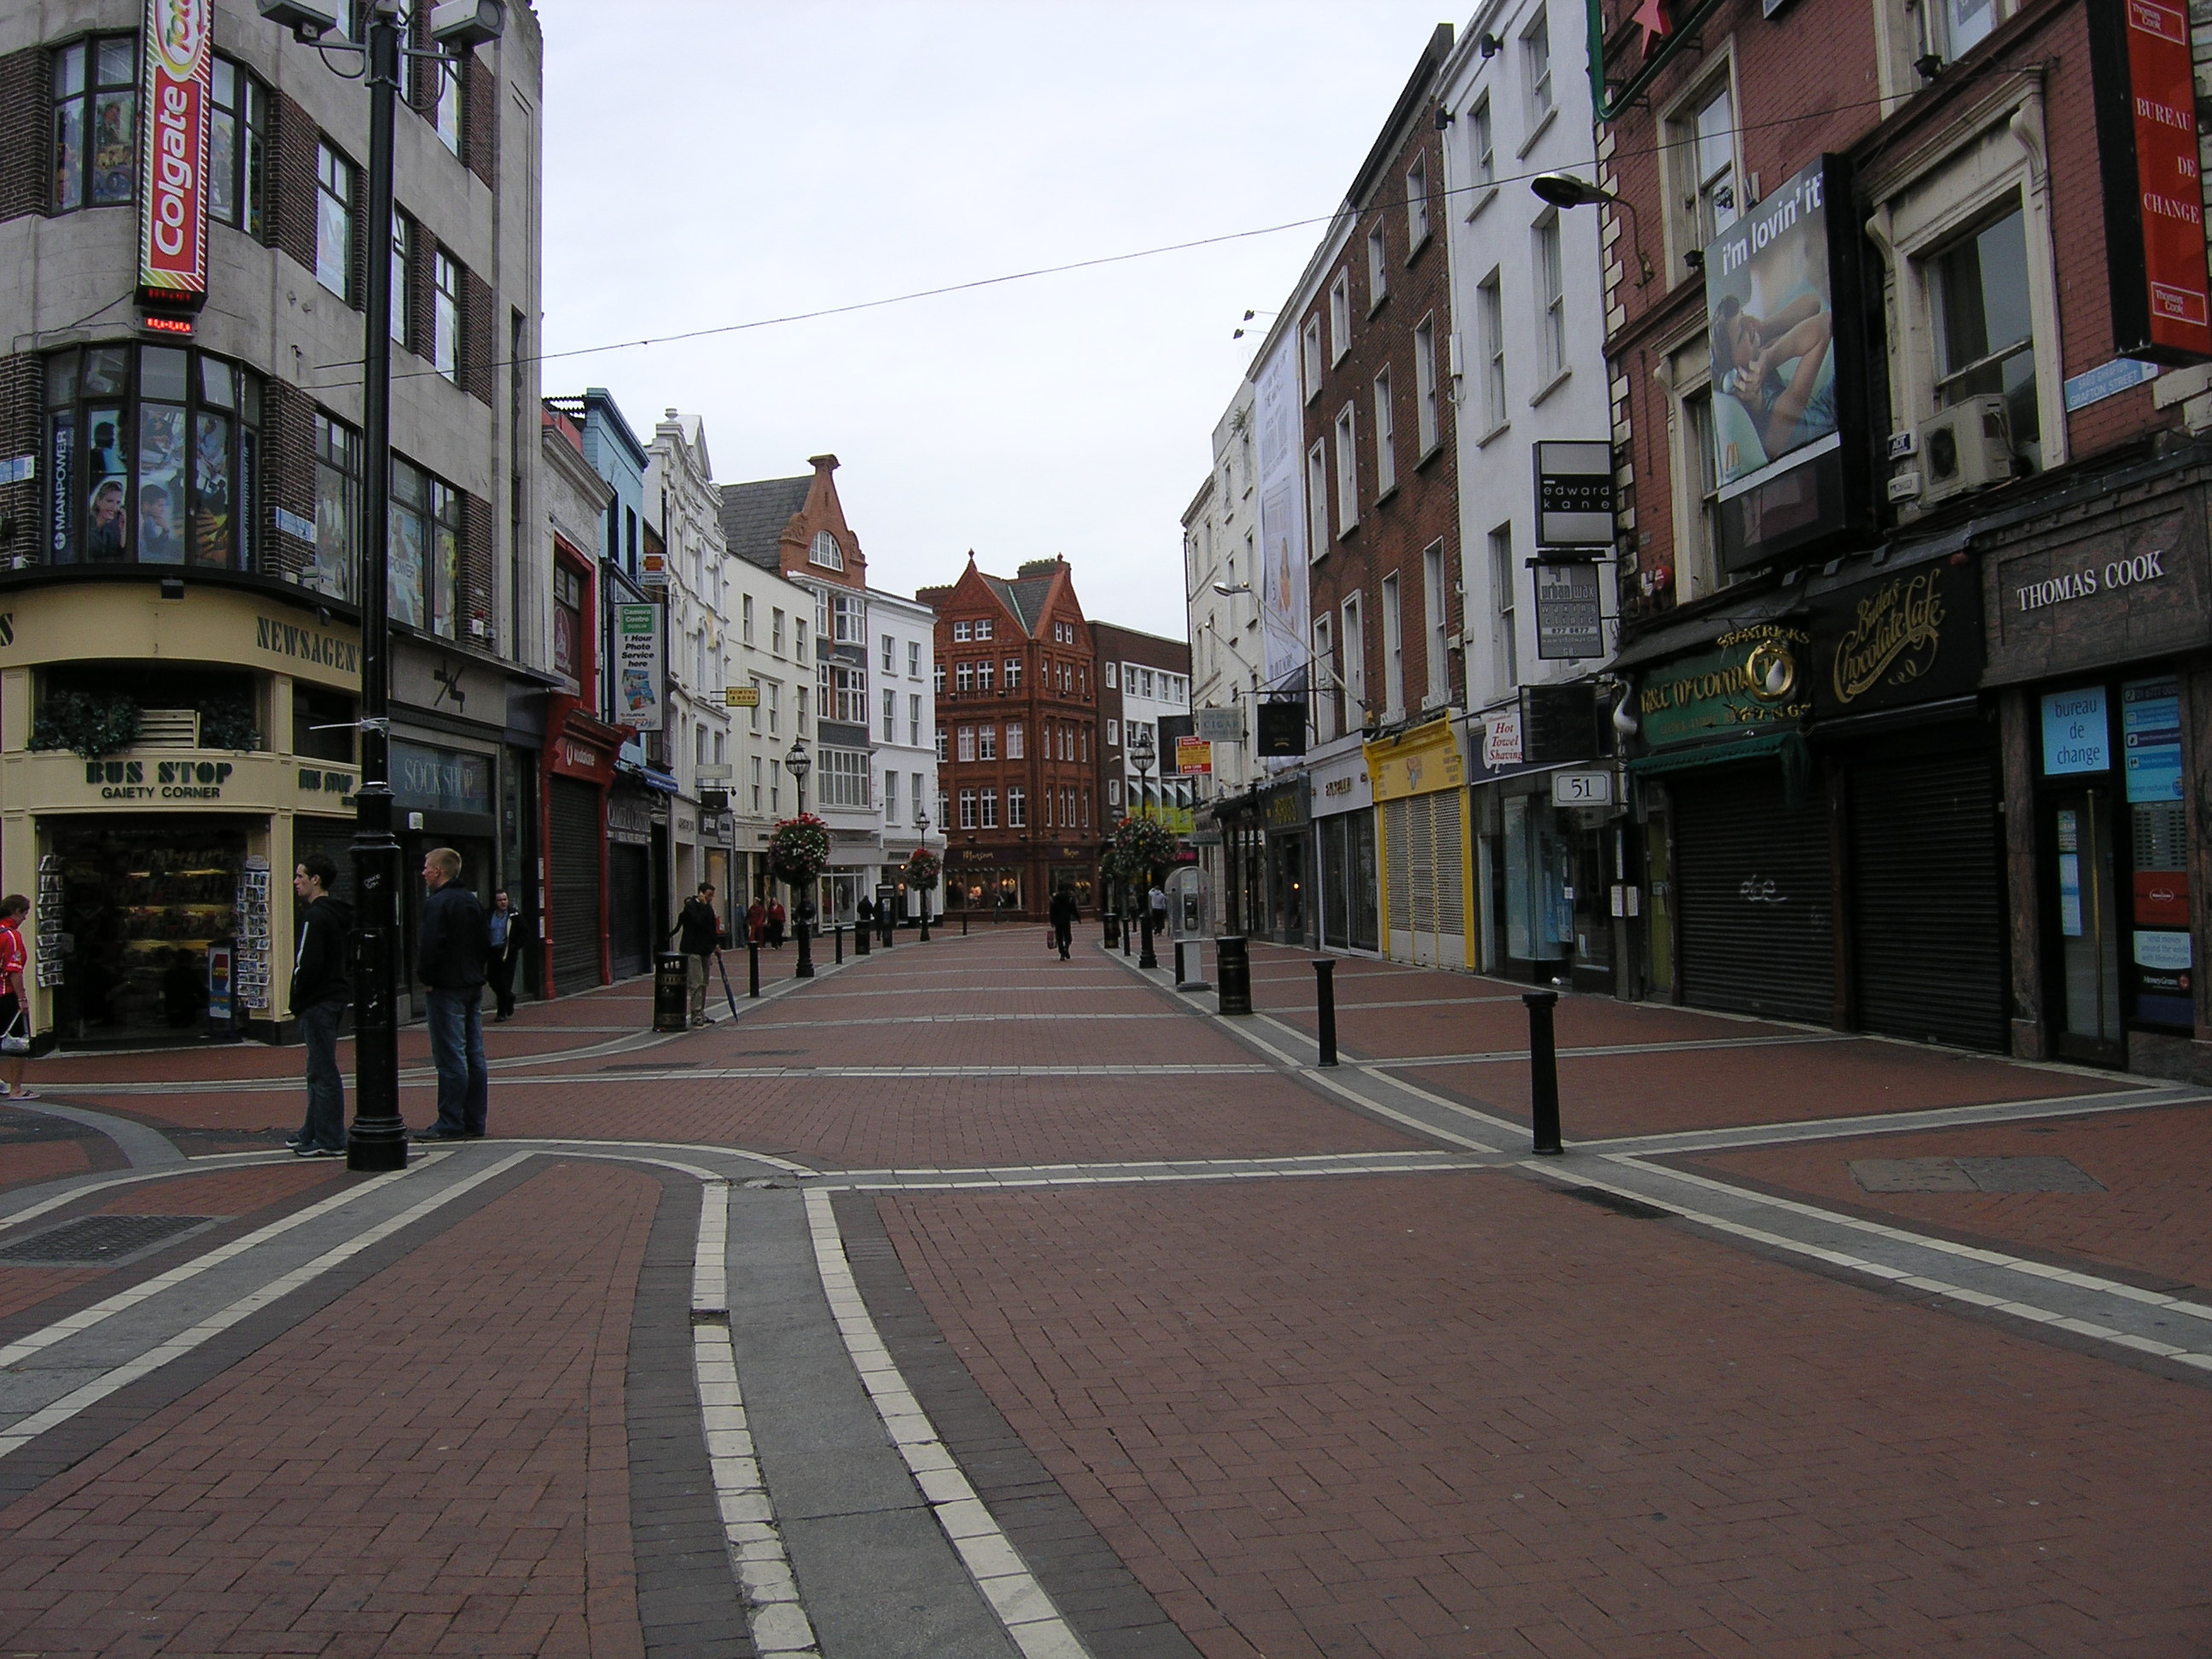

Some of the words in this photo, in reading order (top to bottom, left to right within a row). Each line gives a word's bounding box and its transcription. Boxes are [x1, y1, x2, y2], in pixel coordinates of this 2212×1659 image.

[2136, 97, 2191, 131] BUREAU
[154, 86, 193, 256] Colgate
[2177, 156, 2196, 178] DE
[2144, 193, 2199, 224] CHANGE
[1723, 238, 1748, 276] i'm
[1751, 187, 1801, 254] lovin'
[1805, 175, 1821, 214] it
[2155, 289, 2184, 305] Thomas
[2165, 300, 2184, 315] Cook
[2069, 384, 2107, 406] GRAFTON
[2109, 370, 2138, 391] STREET
[55, 430, 67, 530] MANPOWER
[1543, 485, 1610, 495] edward
[1543, 498, 1610, 509] kane
[2017, 569, 2098, 612] THOMAS
[2104, 550, 2165, 589] COOK
[257, 616, 360, 673] NEWSAGEN
[2055, 700, 2097, 718] bureau
[1203, 720, 1239, 729] CIGAR
[1495, 722, 1514, 733] Hot
[2069, 721, 2085, 739] de
[1492, 735, 1519, 747] Towel
[574, 748, 595, 766] vodafone
[1489, 749, 1523, 761] Shaving
[2058, 745, 2100, 765] change
[86, 761, 143, 783] BUS
[158, 761, 233, 783] STOP
[405, 758, 440, 795] SOCK
[444, 765, 473, 798] SHOP
[102, 787, 155, 799] GAIETY
[161, 786, 220, 798] CORNER
[1571, 777, 1592, 798] 51
